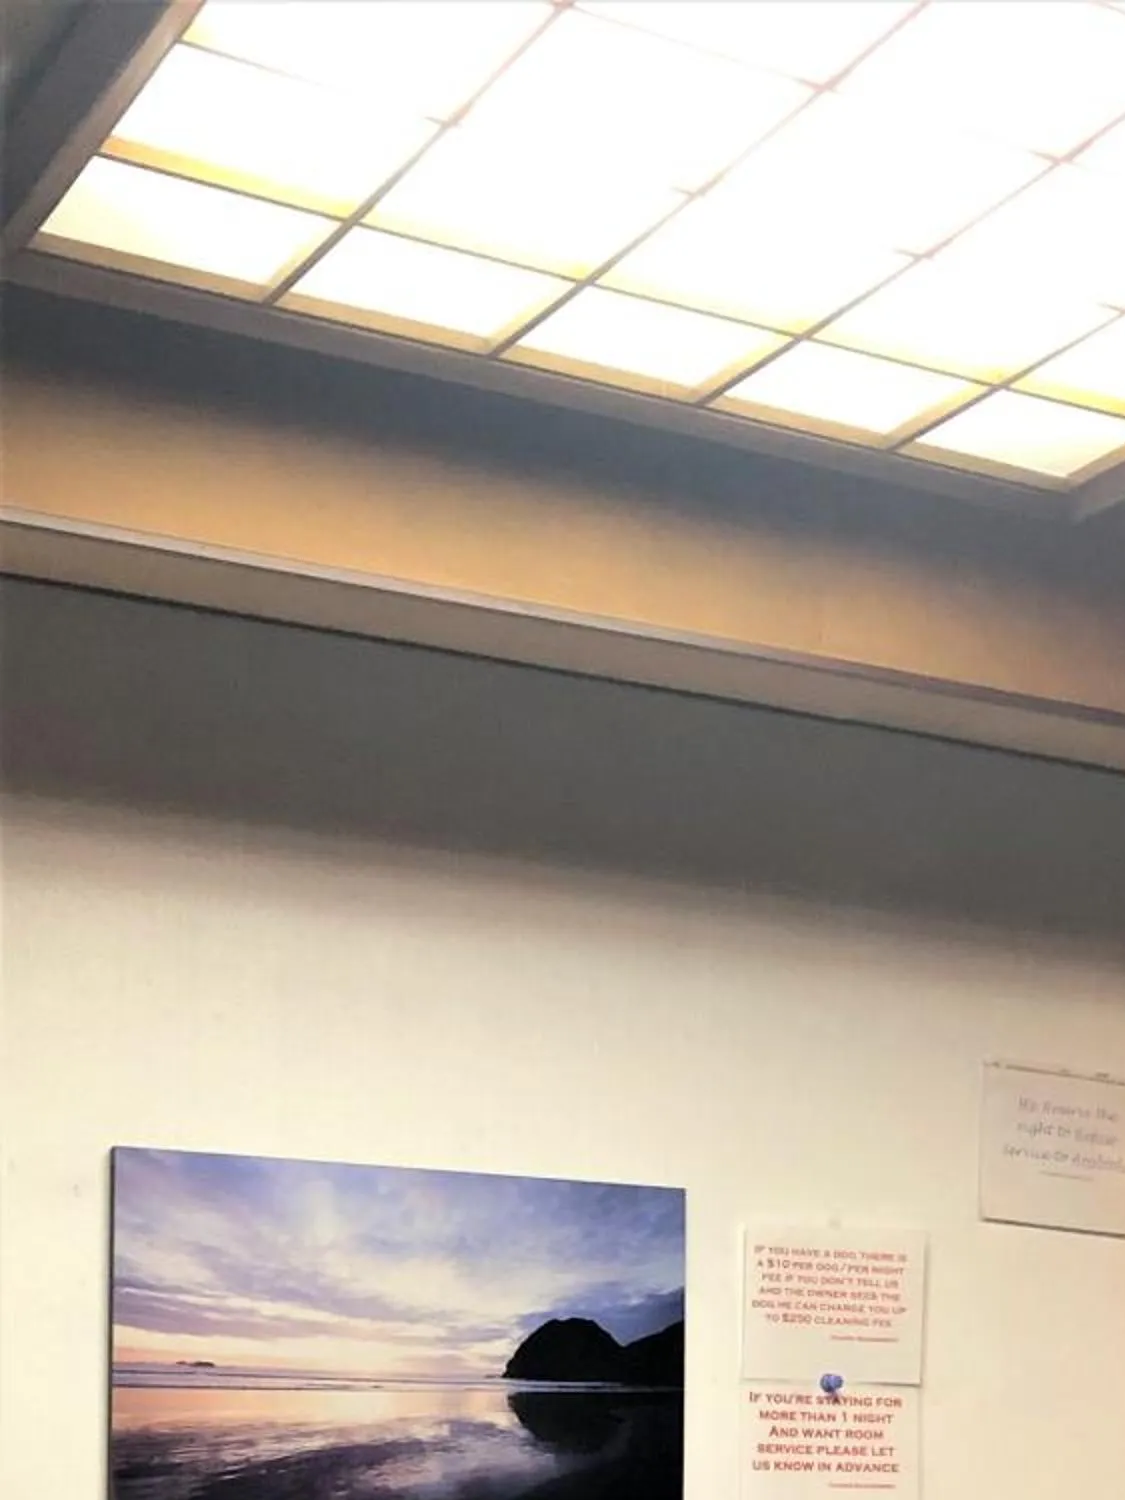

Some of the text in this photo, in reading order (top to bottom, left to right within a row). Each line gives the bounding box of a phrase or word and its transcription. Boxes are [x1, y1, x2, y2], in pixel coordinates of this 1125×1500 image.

[768, 1246, 789, 1256] YOU
[791, 1248, 819, 1258] HAVE
[861, 1251, 895, 1261] THERE
[767, 1258, 790, 1269] $10
[792, 1261, 813, 1270] PER
[871, 1266, 905, 1276] NIGHT
[762, 1273, 782, 1283] FEE
[798, 1275, 818, 1285] YOU
[857, 1277, 880, 1288] TELL
[884, 1280, 899, 1289] US
[759, 1286, 781, 1295] AND
[784, 1287, 804, 1297] THE
[807, 1289, 848, 1299] OWNER
[881, 1292, 901, 1302] THE
[751, 1300, 776, 1309] DOG
[795, 1302, 816, 1311] CAN
[819, 1303, 865, 1314] CHARGE
[868, 1305, 889, 1315] YOU
[892, 1306, 907, 1315] UP
[814, 1315, 870, 1328] CLEANING
[815, 1395, 873, 1407] STAYING
[876, 1397, 903, 1408] FOR
[759, 1410, 894, 1425] MORE THAN 1 NIGHT
[802, 1428, 841, 1439] WANT
[845, 1429, 885, 1440] ROOM
[757, 1443, 896, 1457] SERVICE PLEASE LET
[752, 1460, 900, 1474] US KNOW IN ADVANCE
